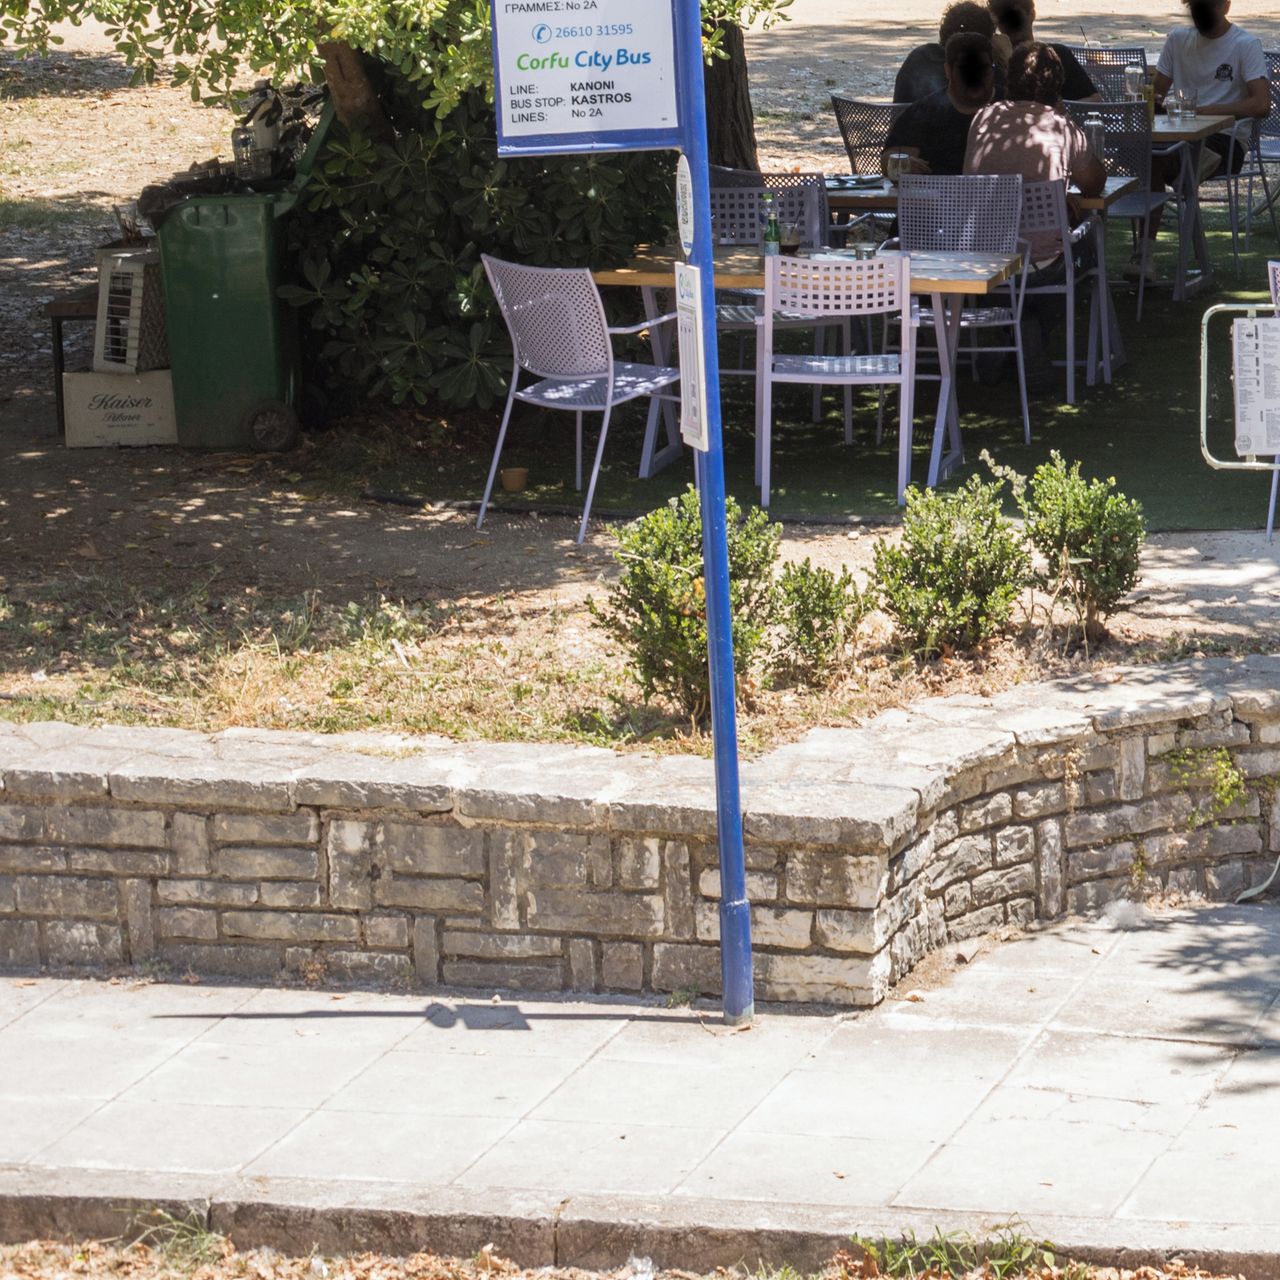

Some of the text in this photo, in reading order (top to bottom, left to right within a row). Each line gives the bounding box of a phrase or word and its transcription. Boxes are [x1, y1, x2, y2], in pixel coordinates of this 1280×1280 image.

[505, 0, 597, 13] ΓΡΑΜΜΕΣ: No 2A
[555, 24, 633, 38] 26610 31595
[517, 48, 651, 72] Corfu City Bus
[510, 81, 614, 95] LINE: KANONI
[511, 92, 632, 109] BUS STOP: KASTROS
[511, 108, 603, 123] LINES: No 2A
[87, 393, 153, 411] Kaiser
